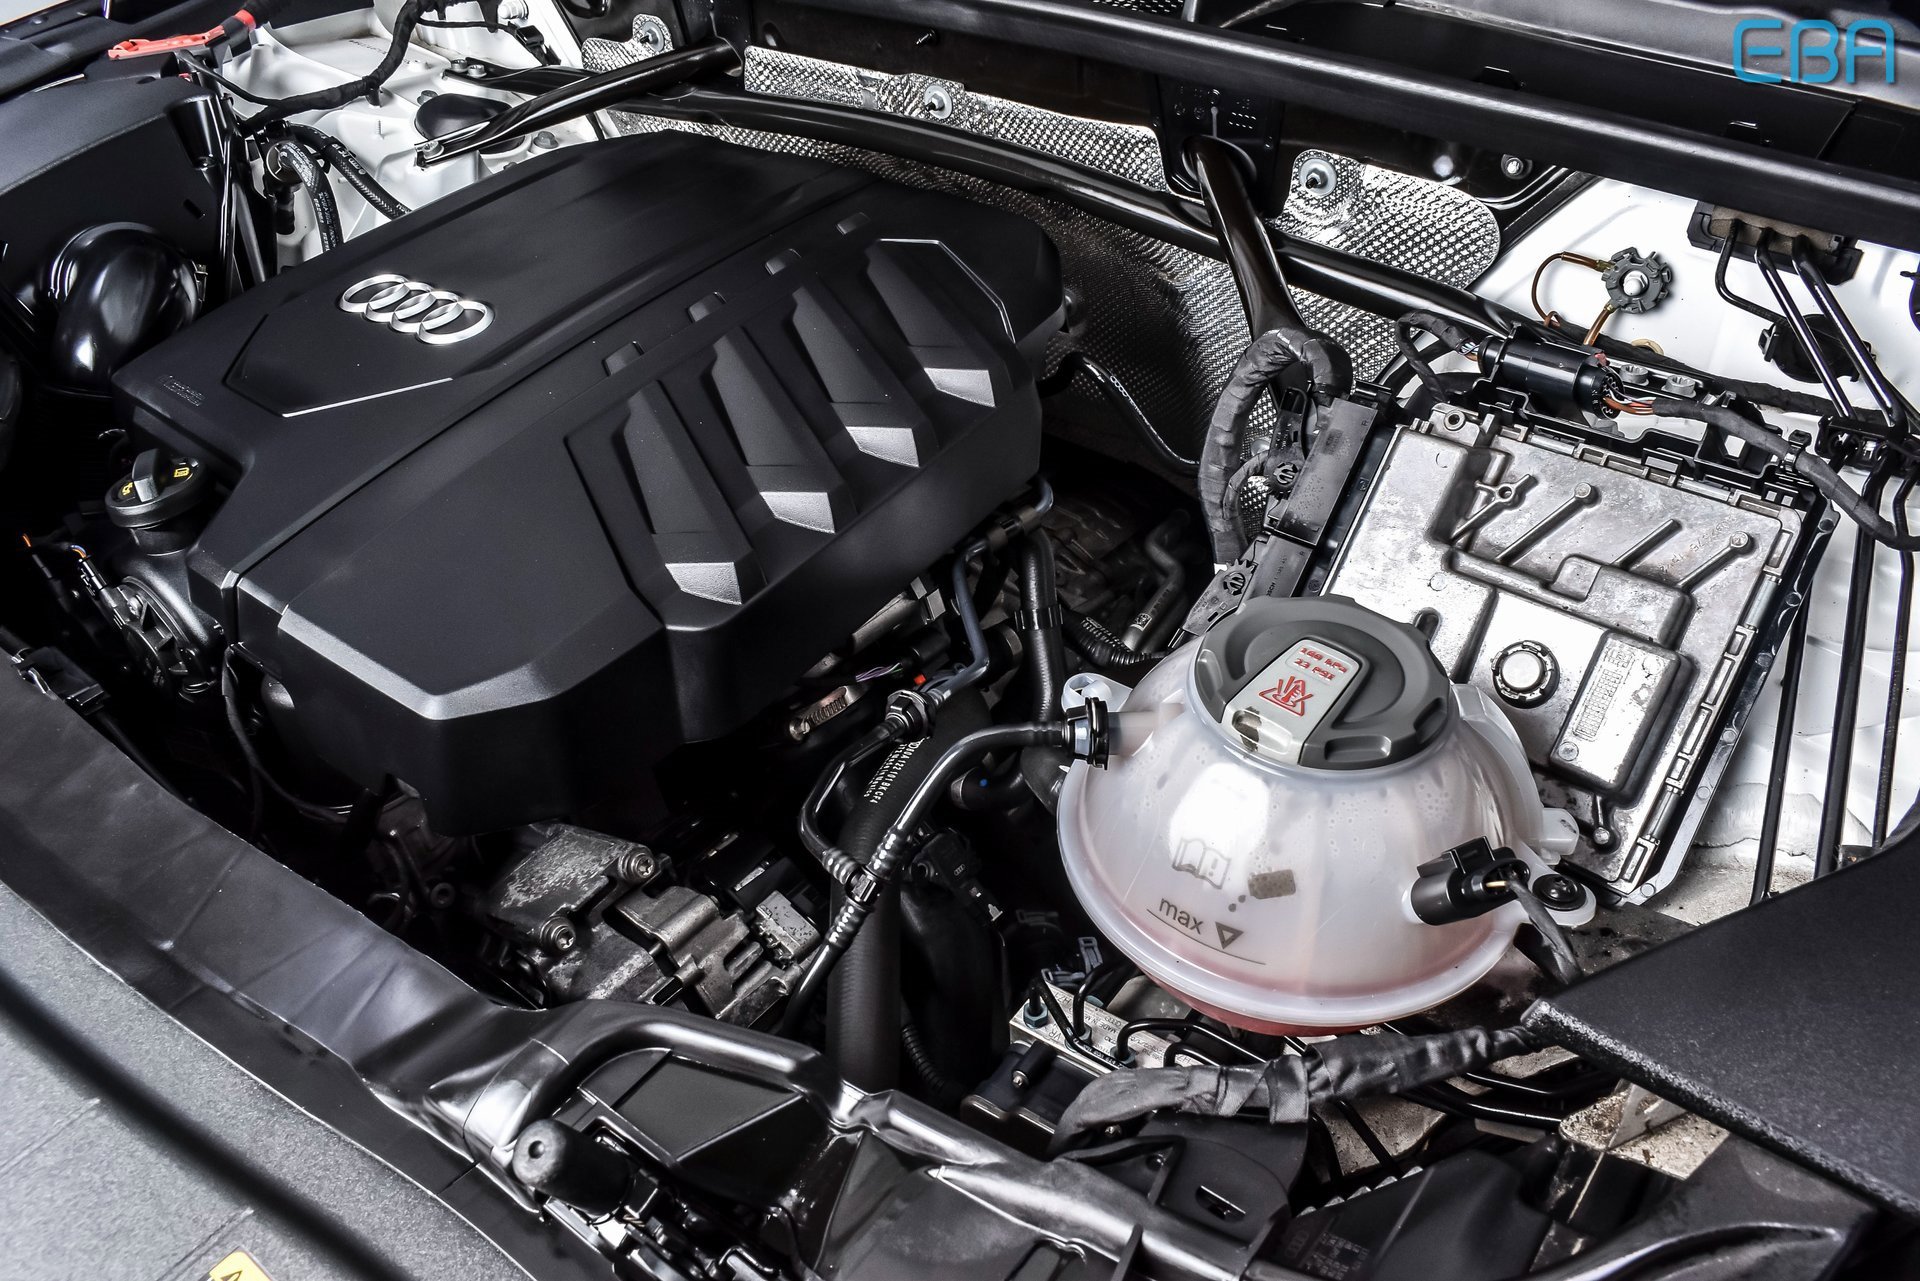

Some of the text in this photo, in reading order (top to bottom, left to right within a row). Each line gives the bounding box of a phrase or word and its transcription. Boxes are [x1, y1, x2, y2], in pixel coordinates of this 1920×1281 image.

[1294, 657, 1310, 669] 23
[1159, 898, 1204, 934] max
[1099, 1020, 1117, 1034] MADE
